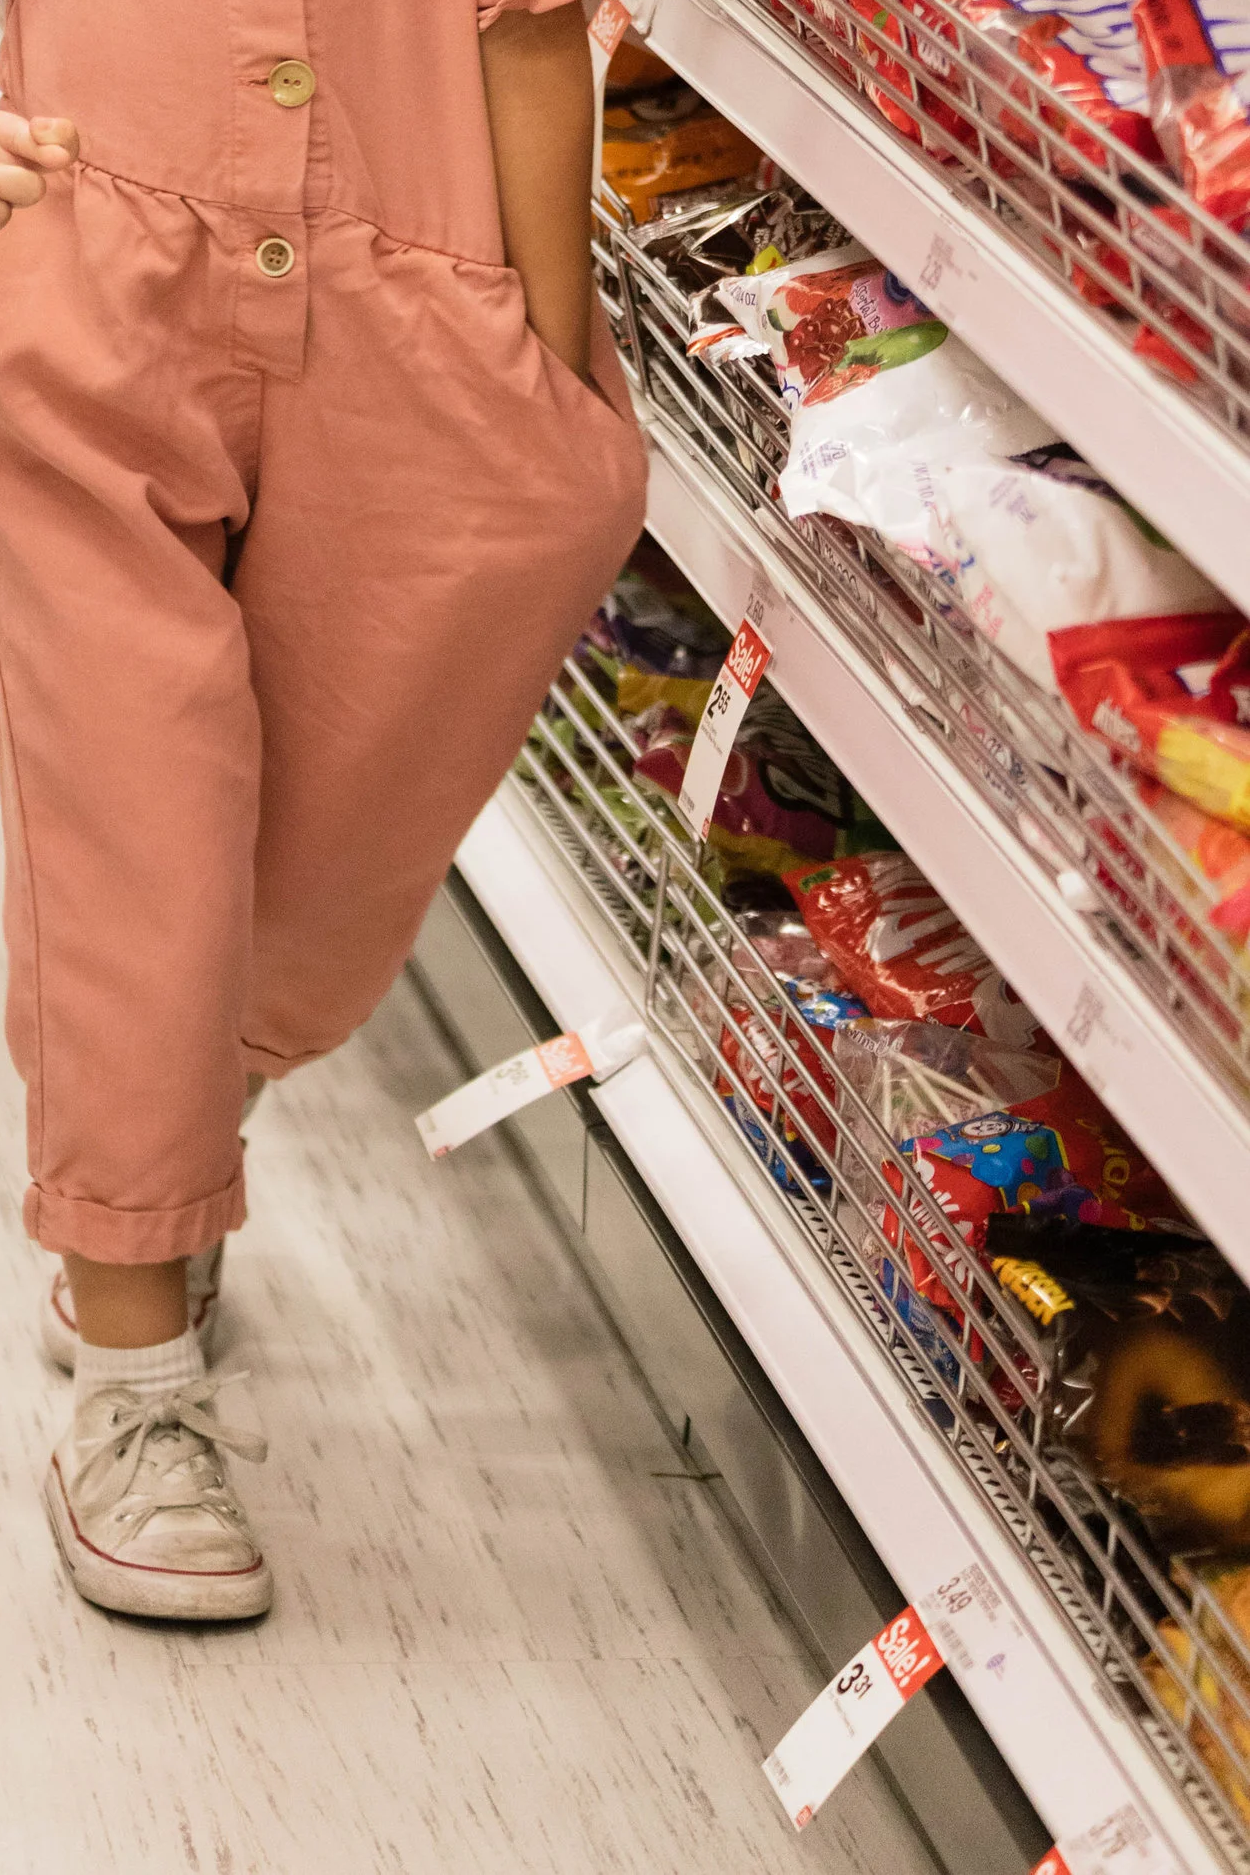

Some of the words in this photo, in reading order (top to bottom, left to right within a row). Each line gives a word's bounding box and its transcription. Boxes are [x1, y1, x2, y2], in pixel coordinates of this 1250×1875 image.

[728, 632, 763, 690] Sale!
[936, 1576, 973, 1615] 3.49
[877, 1617, 931, 1688] Sale!
